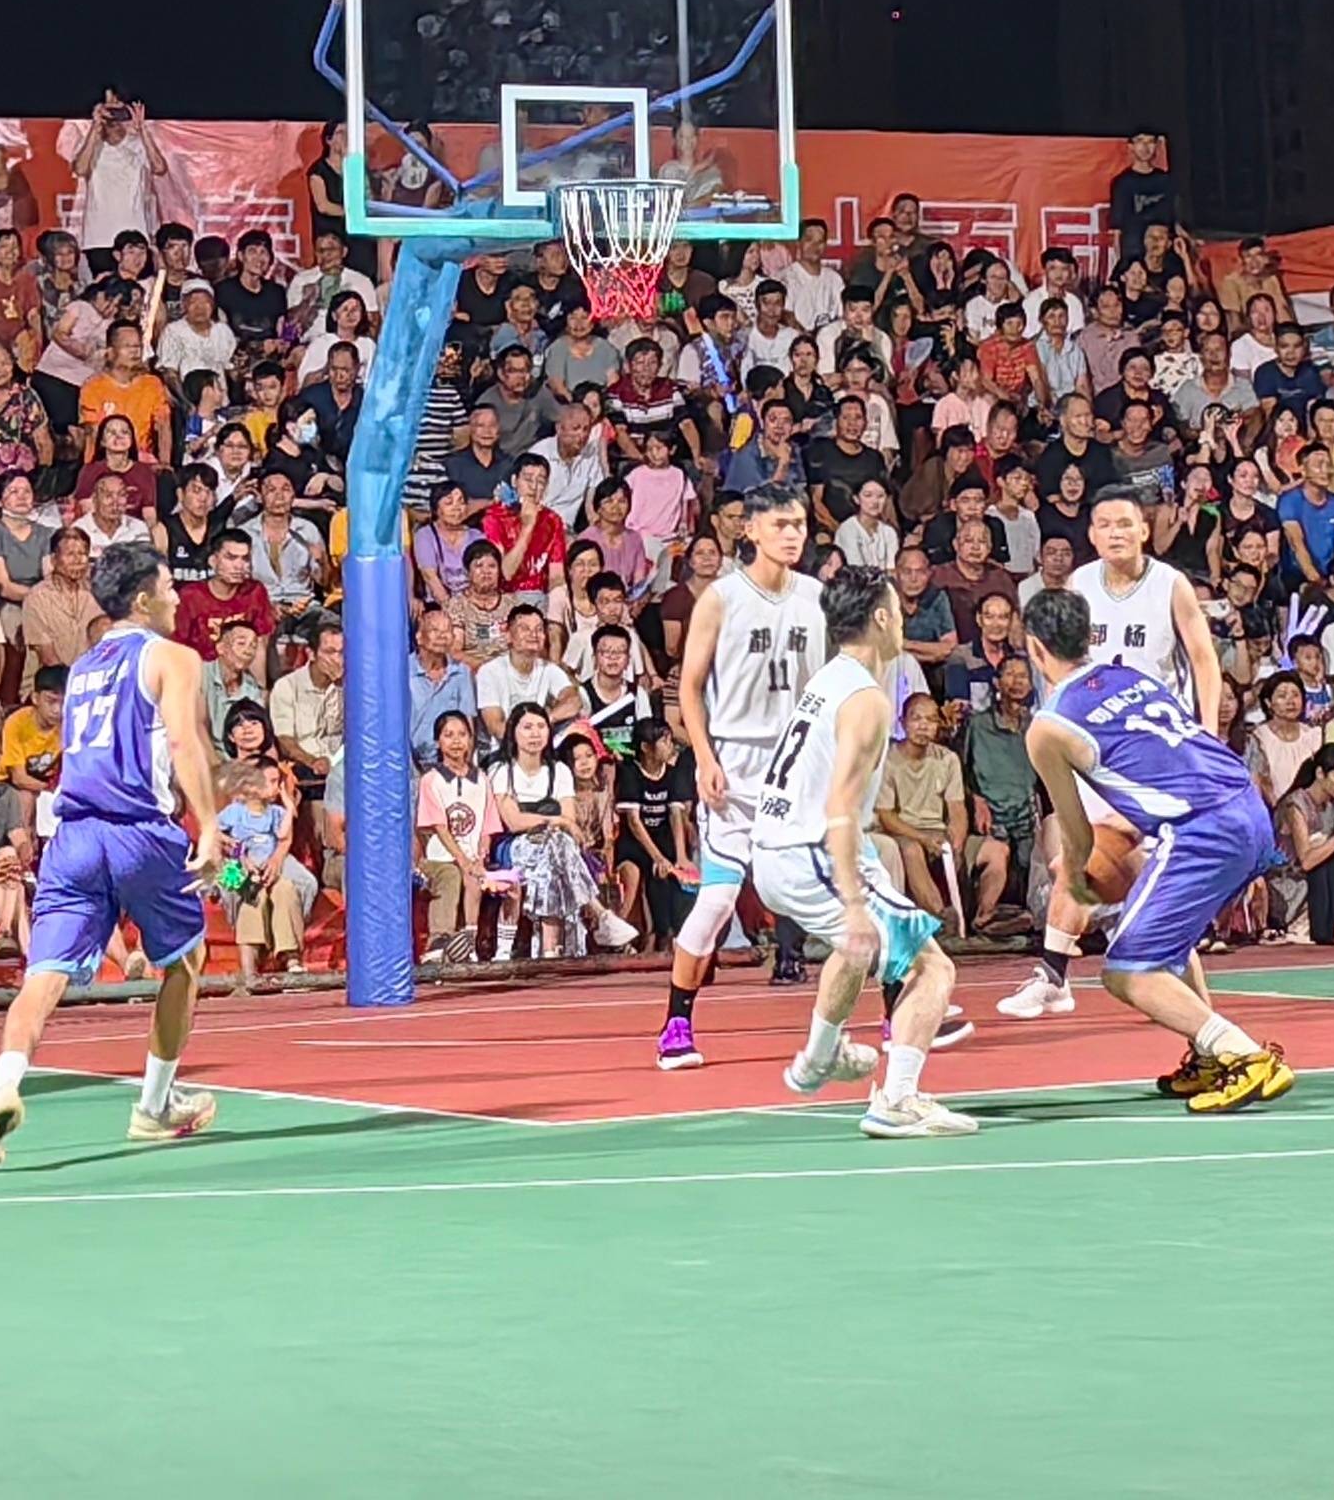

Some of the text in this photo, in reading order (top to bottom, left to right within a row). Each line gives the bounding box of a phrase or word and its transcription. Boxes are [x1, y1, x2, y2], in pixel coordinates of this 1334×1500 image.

[768, 658, 792, 692] 11
[63, 693, 118, 755] 17
[764, 717, 813, 791] 12
